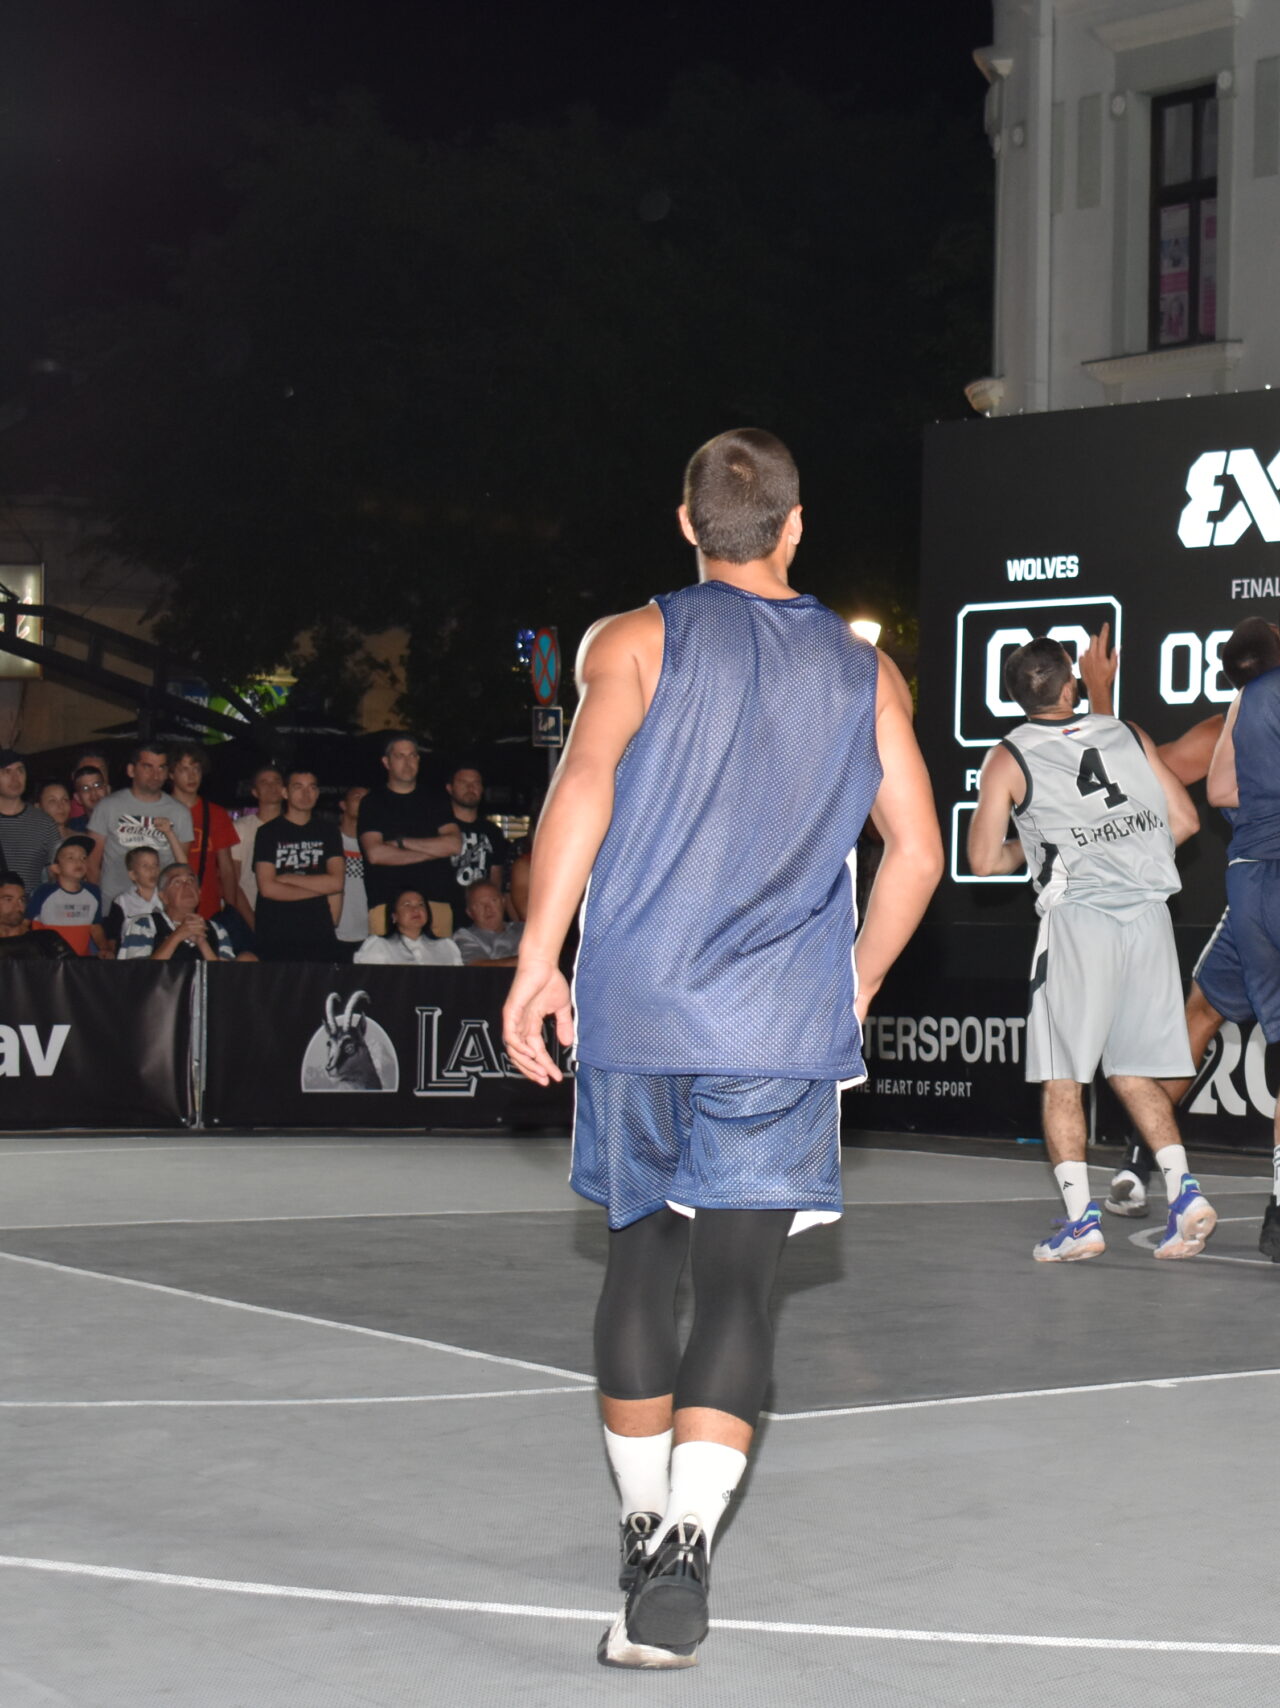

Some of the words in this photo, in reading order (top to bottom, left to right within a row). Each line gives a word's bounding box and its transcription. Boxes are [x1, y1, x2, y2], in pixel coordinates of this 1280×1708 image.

[1006, 555, 1080, 582] WOLVES
[1076, 747, 1129, 809] 4
[275, 849, 324, 869] FAST
[876, 1079, 913, 1095] HEART
[916, 1081, 931, 1096] OF
[935, 1081, 973, 1098] SPORT
